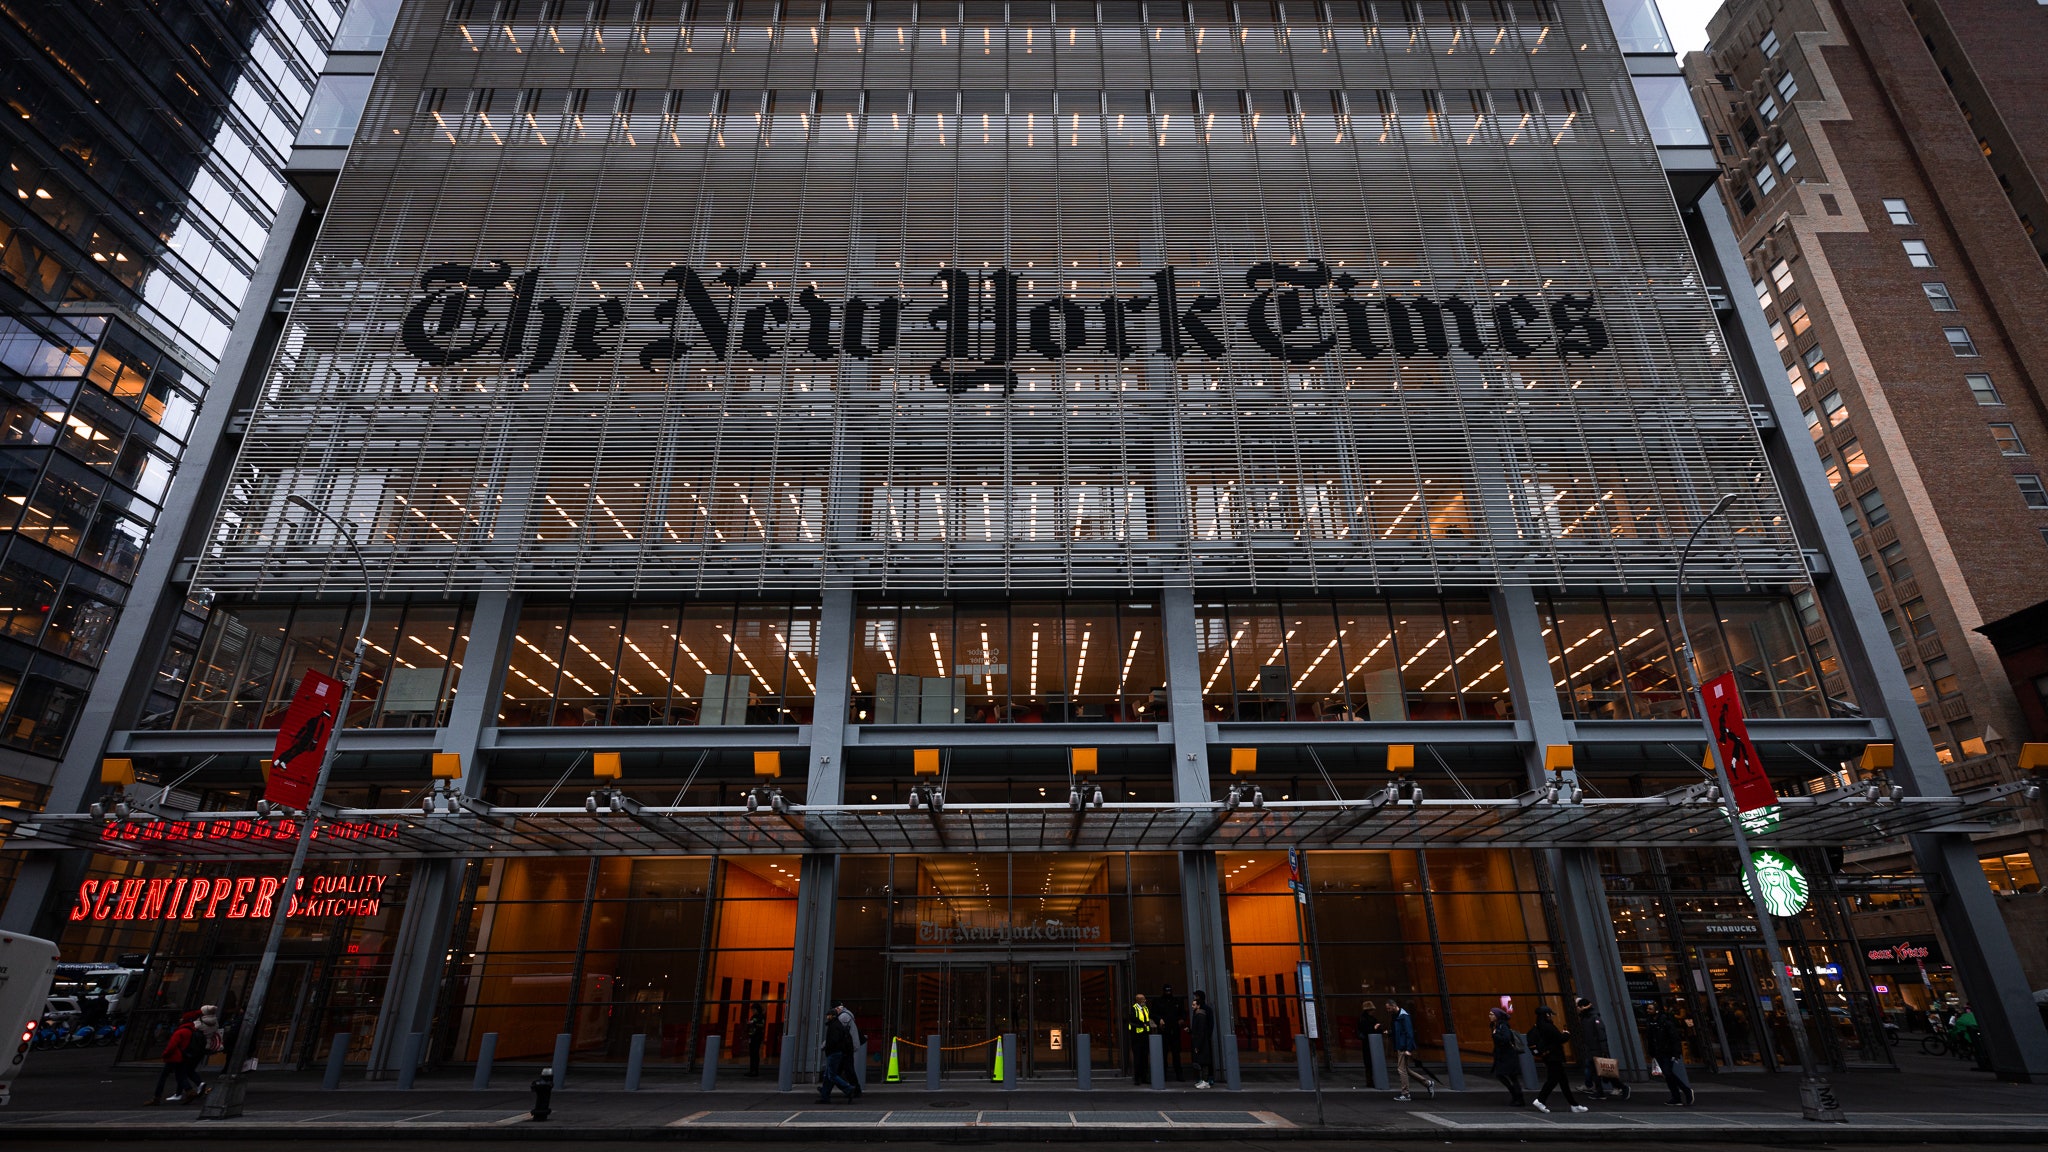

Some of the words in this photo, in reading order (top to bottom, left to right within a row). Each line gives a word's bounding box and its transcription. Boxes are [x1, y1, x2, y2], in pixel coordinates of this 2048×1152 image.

[401, 259, 624, 377] The
[639, 264, 913, 373] New
[929, 264, 1227, 396] York
[1245, 259, 1608, 365] Times
[313, 875, 387, 893] QUALITY
[306, 898, 380, 917] KITCHEN
[919, 920, 954, 943] The
[952, 920, 995, 942] New
[994, 920, 1045, 945] York
[1045, 919, 1100, 941] Times
[1706, 925, 1757, 933] STARBUCKS
